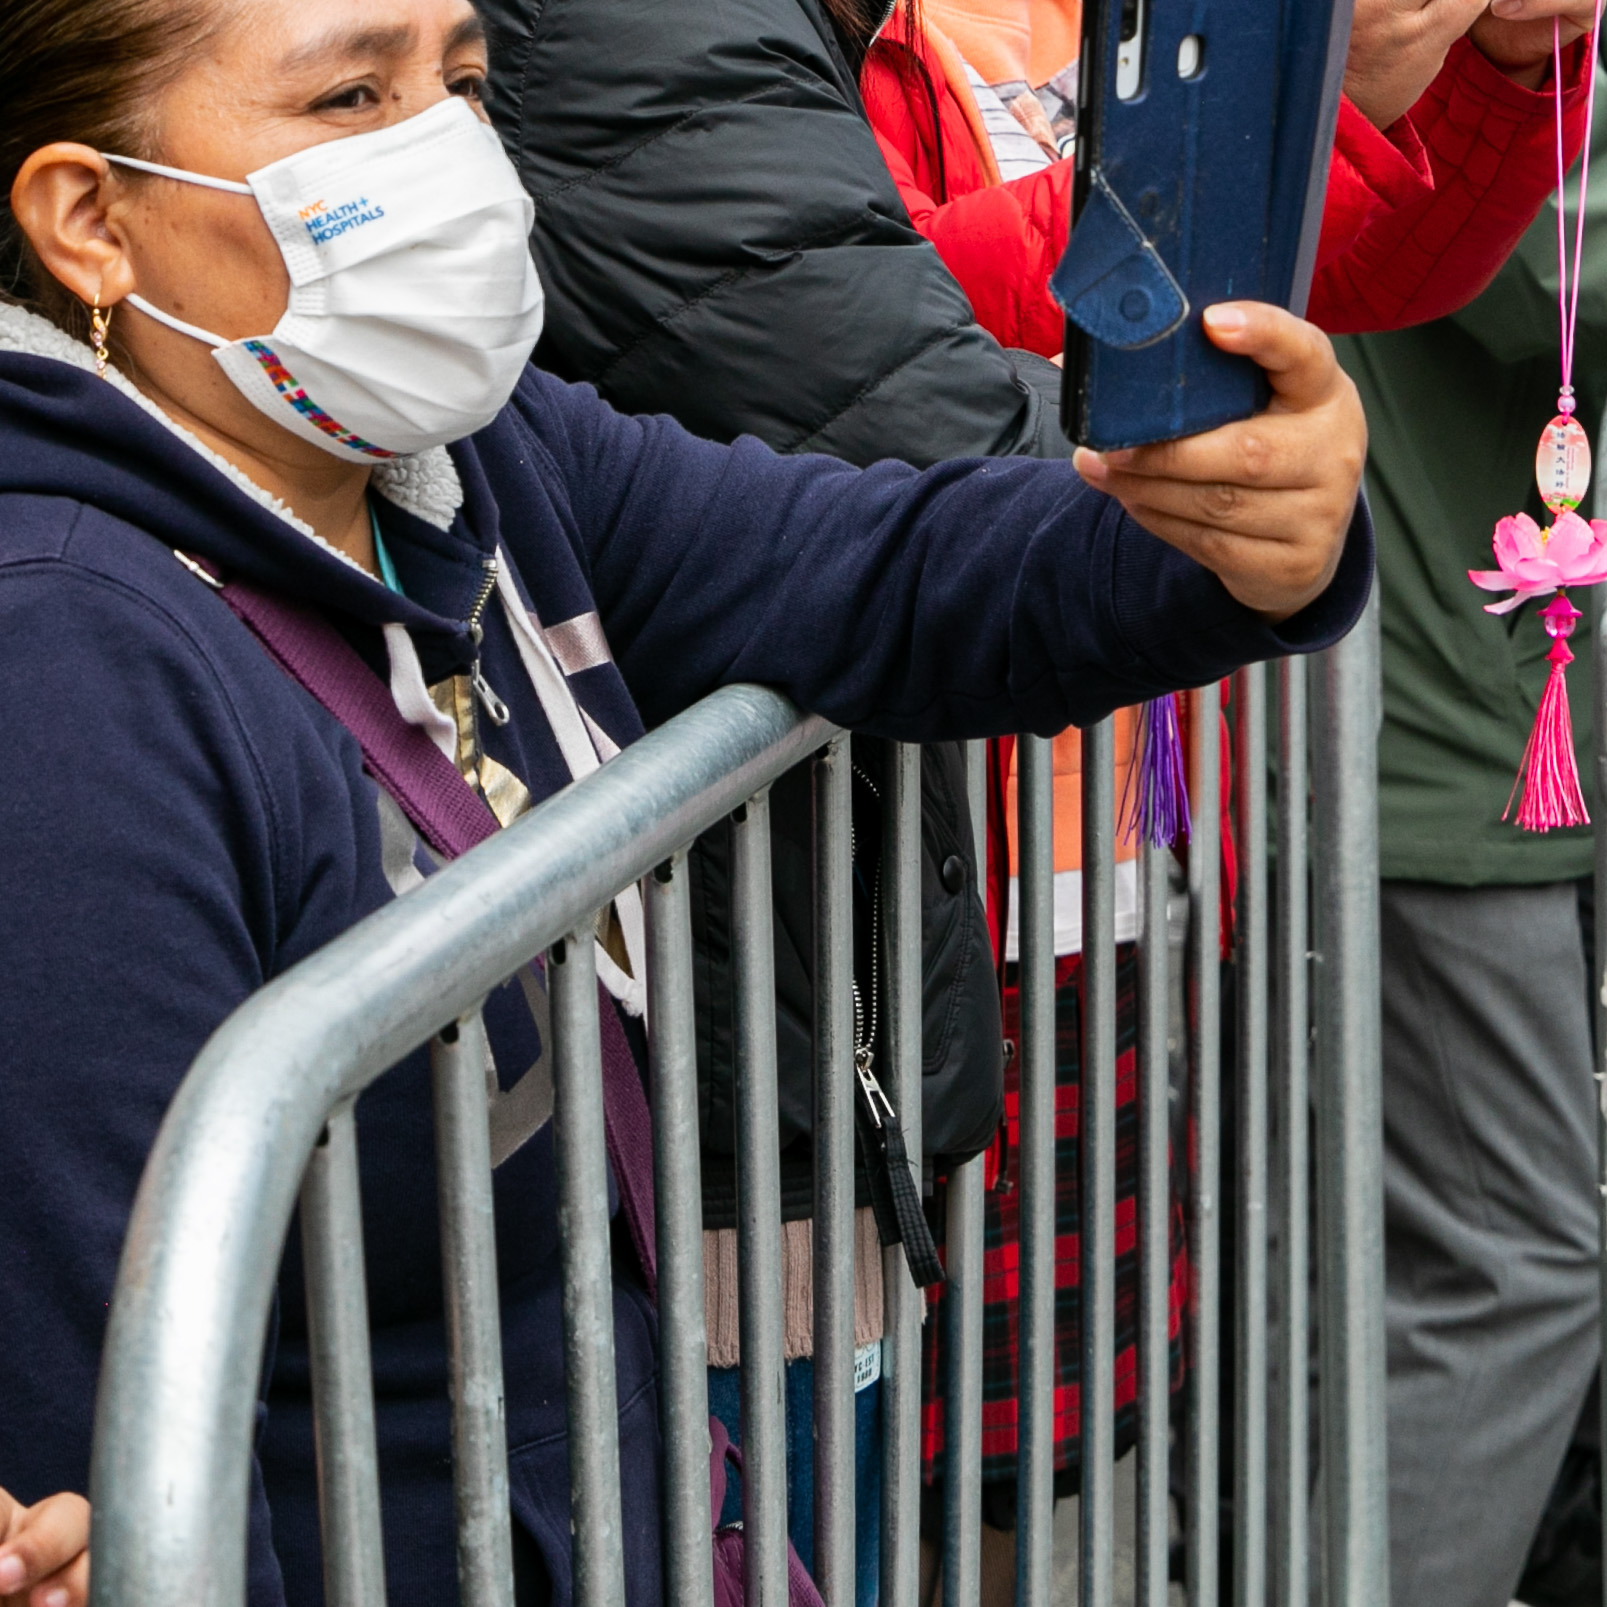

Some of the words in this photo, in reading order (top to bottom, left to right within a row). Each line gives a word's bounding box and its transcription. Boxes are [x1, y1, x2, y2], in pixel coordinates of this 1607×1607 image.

[299, 200, 328, 220] NYC
[306, 202, 359, 232] HEALTH
[312, 206, 384, 245] HOSPITALS
